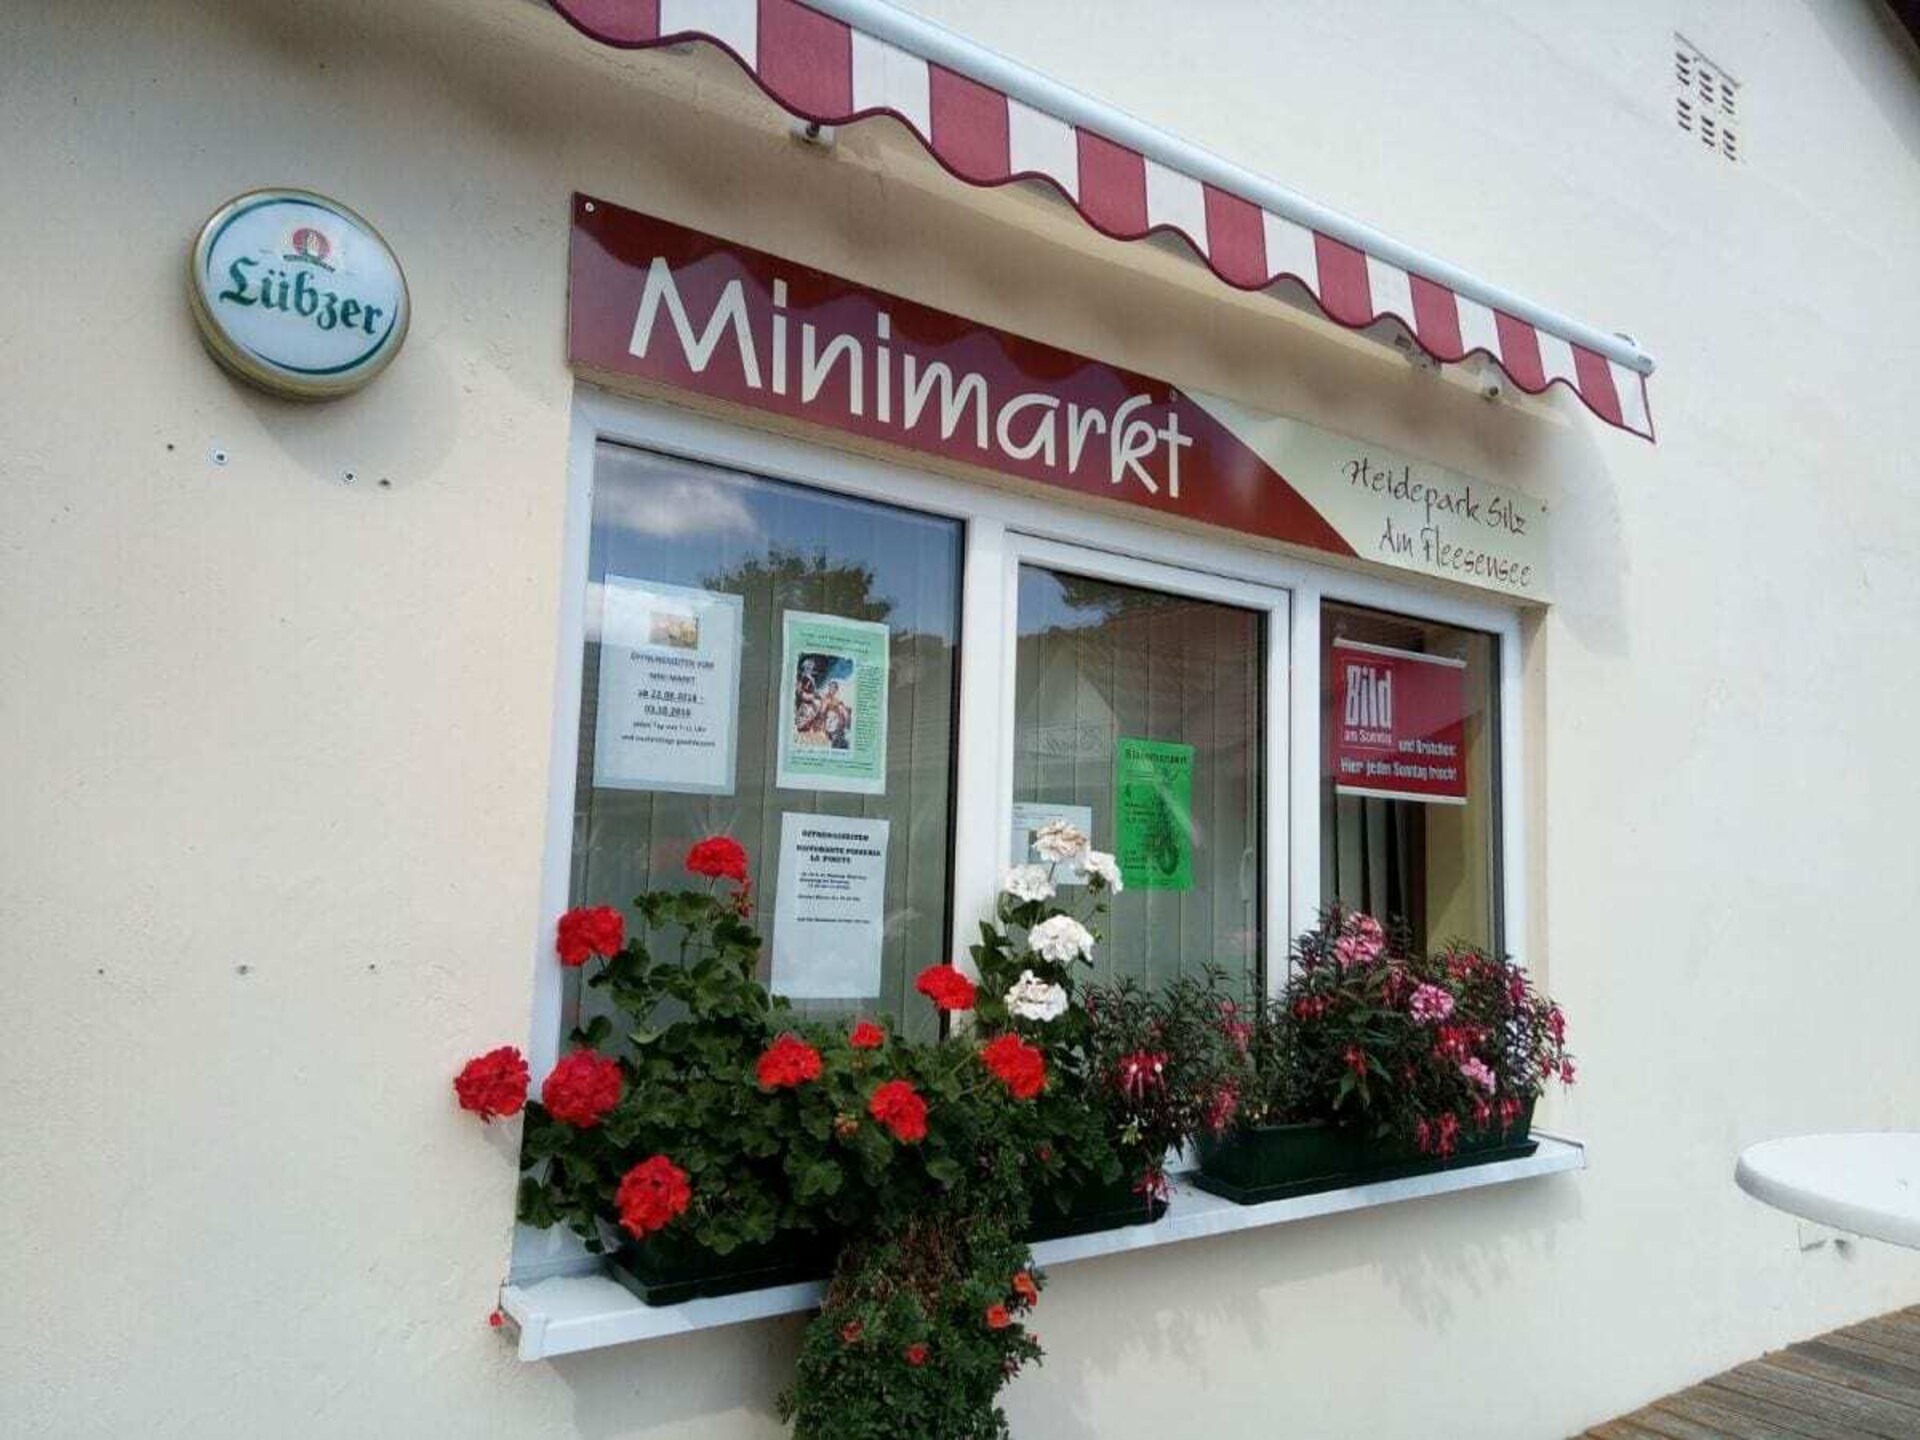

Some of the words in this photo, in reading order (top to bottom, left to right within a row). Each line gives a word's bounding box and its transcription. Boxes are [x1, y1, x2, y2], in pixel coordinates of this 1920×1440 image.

[218, 256, 384, 335] Lübzer
[627, 256, 1194, 498] Minimarkt
[1342, 457, 1481, 524] Heidepark
[1487, 497, 1527, 535] Silz
[1379, 516, 1414, 558] Am
[1418, 525, 1533, 587] Fleesensee
[1344, 664, 1392, 730] Bild
[1393, 761, 1427, 781] Sonntag
